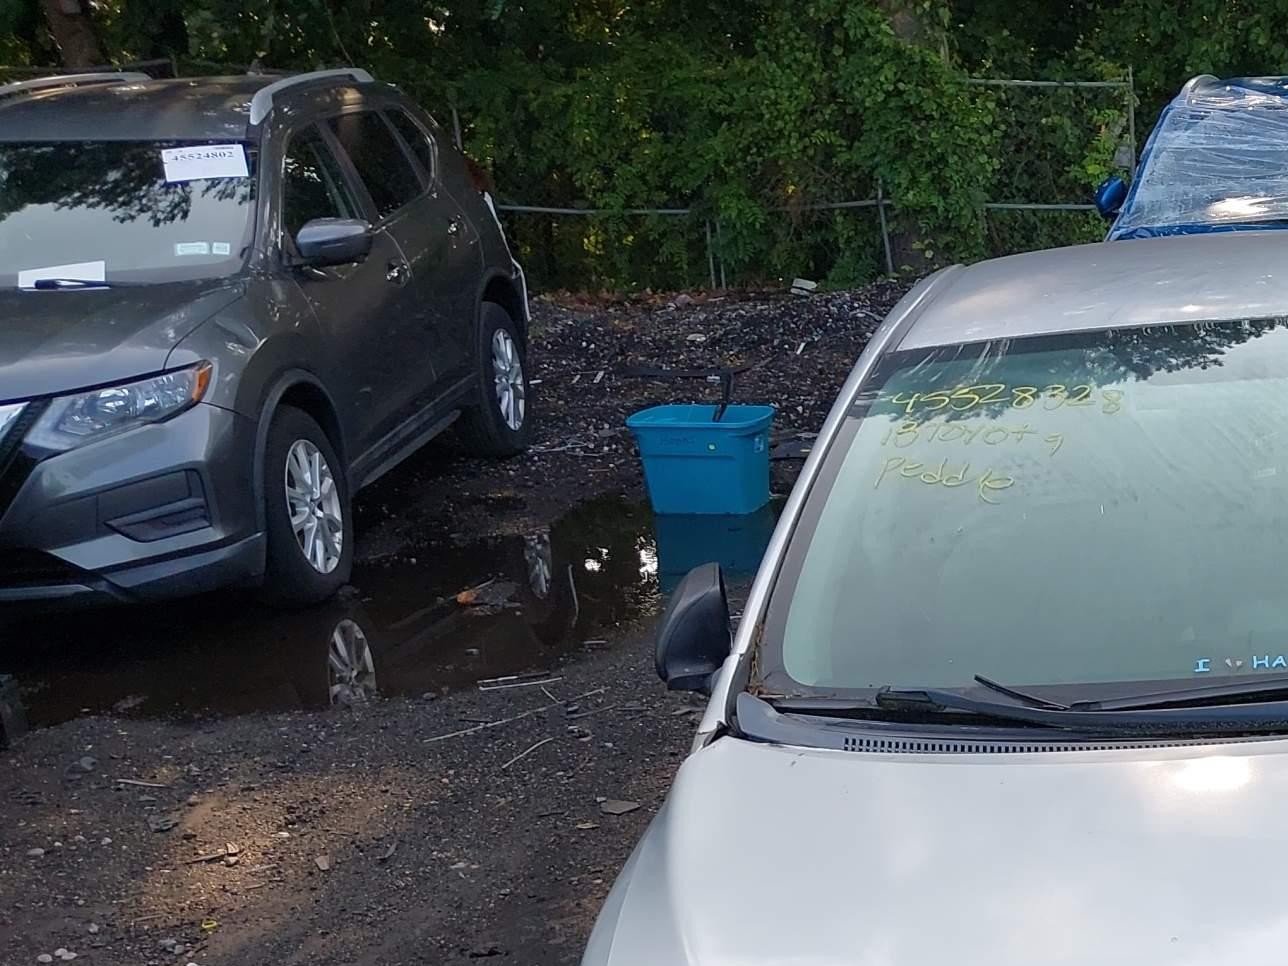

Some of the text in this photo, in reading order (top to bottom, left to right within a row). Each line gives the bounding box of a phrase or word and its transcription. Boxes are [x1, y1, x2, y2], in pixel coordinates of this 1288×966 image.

[172, 151, 234, 161] 45524802
[892, 384, 1124, 415] 45528328
[1194, 658, 1211, 673] I
